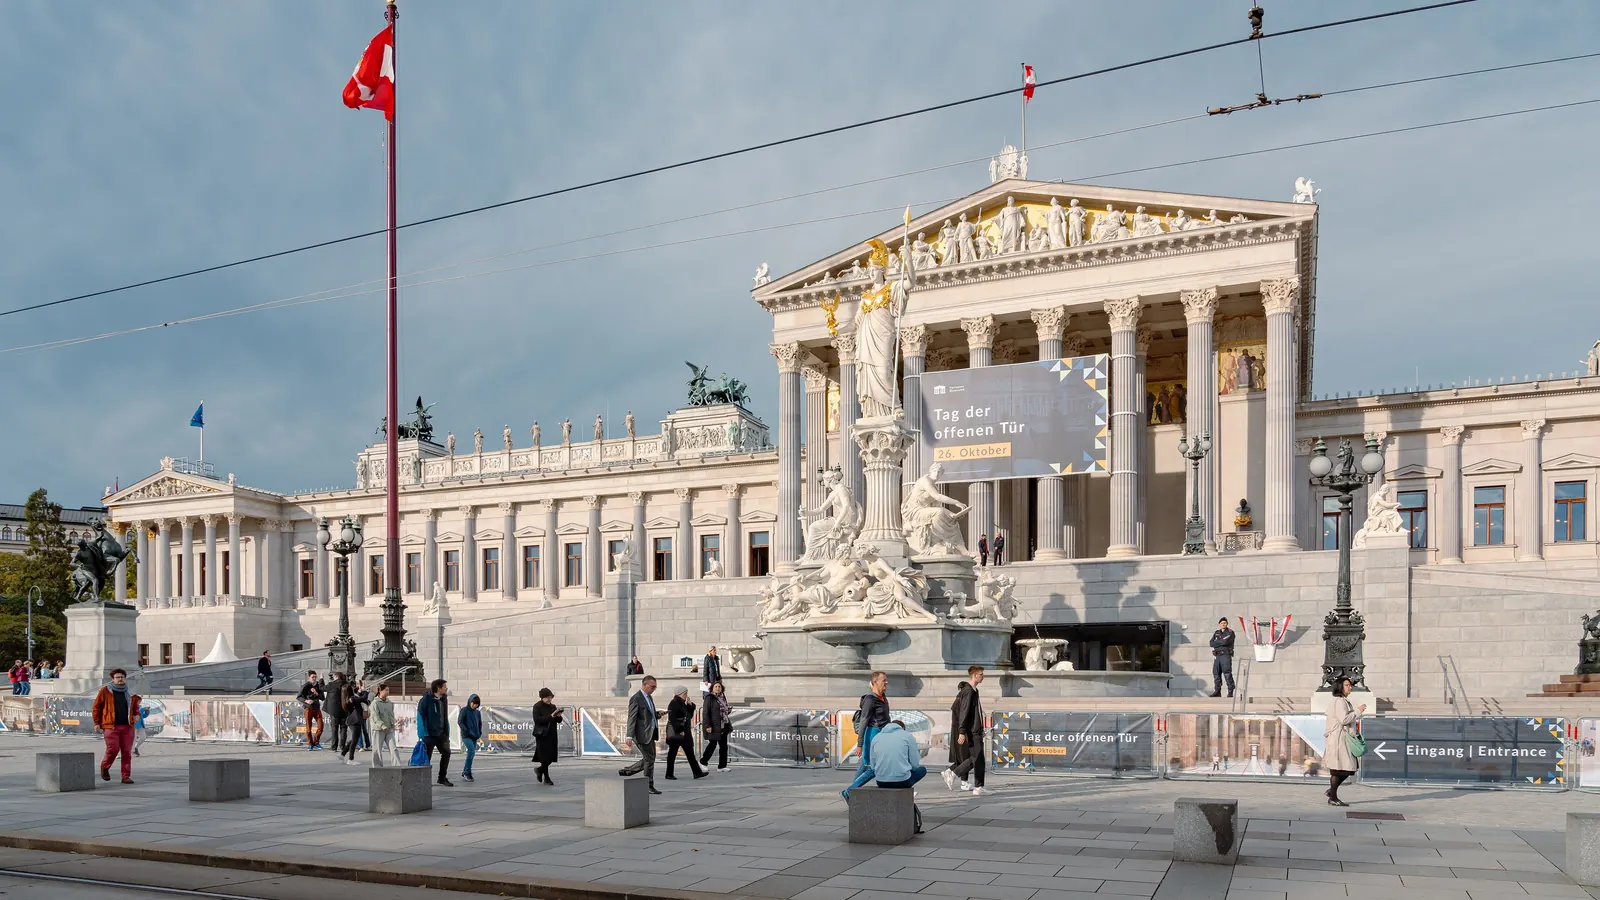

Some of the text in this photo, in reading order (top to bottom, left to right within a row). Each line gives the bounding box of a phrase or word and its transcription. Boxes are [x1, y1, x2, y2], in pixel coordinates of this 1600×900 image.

[934, 405, 991, 421] Tag der
[934, 421, 1025, 439] offenen Tür
[938, 446, 1008, 459] 26. Oktober
[488, 722, 534, 731] Tag der offe
[730, 730, 767, 741] Eingang
[775, 731, 819, 742] Entrance
[1022, 731, 1138, 743] Tag der offenen Tür
[1406, 745, 1464, 758] Eingang
[1478, 745, 1547, 757] Entrance
